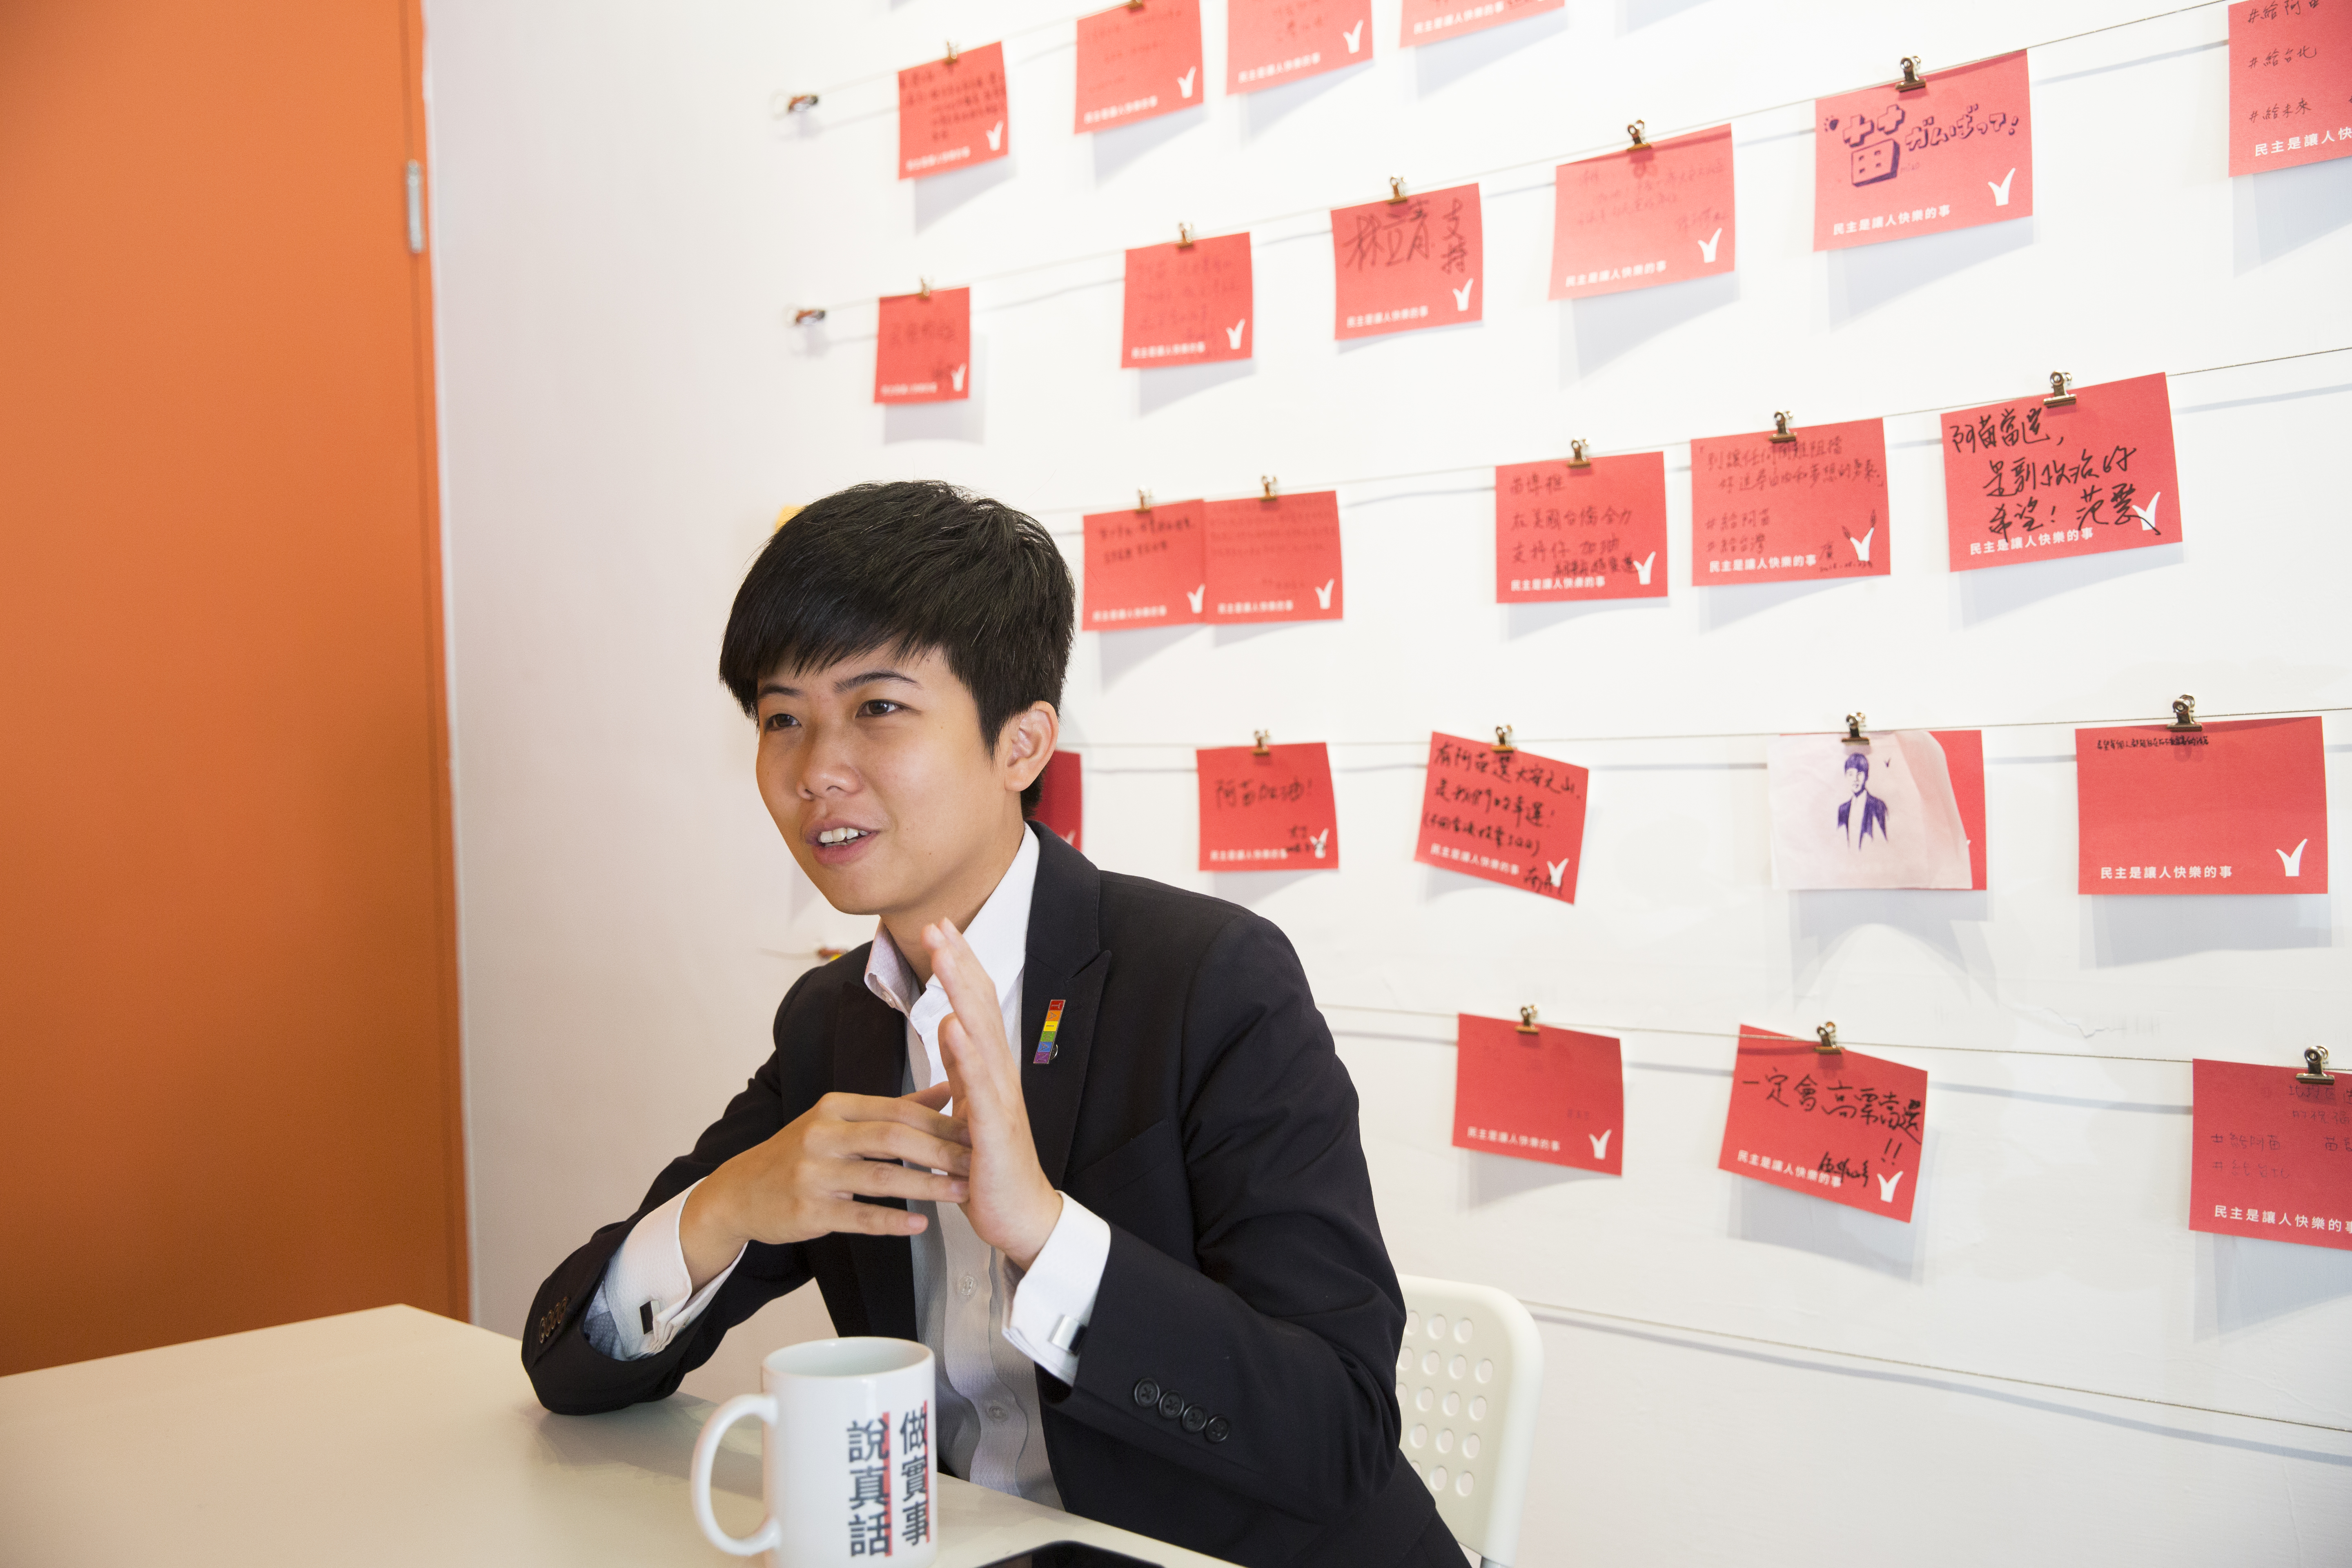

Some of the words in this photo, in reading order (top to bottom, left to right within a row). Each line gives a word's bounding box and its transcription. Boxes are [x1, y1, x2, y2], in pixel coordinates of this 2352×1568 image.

[2255, 127, 2352, 156] 民主是讓人快
[1833, 205, 1951, 236] 民主是讓人快樂的事
[1970, 527, 2094, 556] 民主是讓人快樂的事
[1710, 554, 1816, 573] 民主是讓人快樂的事
[2101, 865, 2232, 879] 民主是讓人快樂的事
[1037, 1003, 1062, 1061] TAIWAN
[847, 1417, 891, 1557] 說真話
[899, 1407, 929, 1546] 做實事
